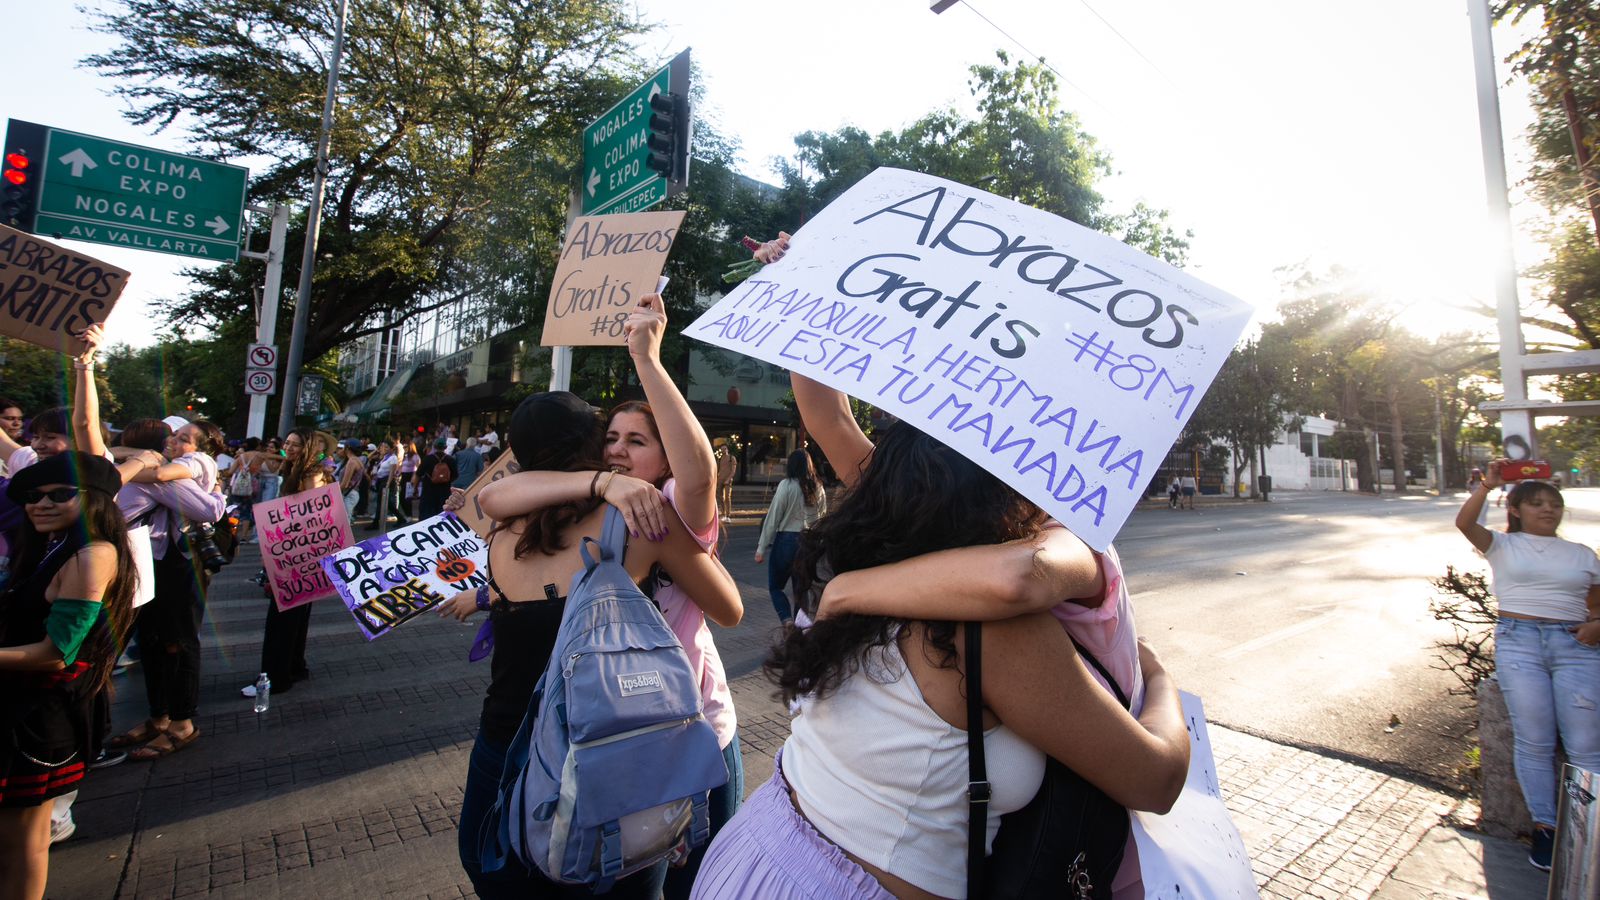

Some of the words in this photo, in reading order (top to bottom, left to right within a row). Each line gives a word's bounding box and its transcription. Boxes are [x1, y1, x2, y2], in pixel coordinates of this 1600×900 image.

[592, 95, 644, 148] NOGALES
[604, 127, 647, 169] COLIMA
[107, 151, 203, 182] COLIMA
[609, 158, 640, 191] EXPO
[120, 175, 186, 200] EXPO
[606, 186, 656, 215] PULTEPEC
[75, 195, 196, 228] NOGALES
[69, 225, 97, 239] AV.
[107, 230, 208, 255] VALLARTA
[563, 221, 674, 260] Abrazos
[0, 234, 120, 298] ABRAZOS
[853, 186, 1199, 349] Abrazos
[0, 274, 105, 337] RATIS
[553, 269, 632, 319] Gratis
[837, 253, 1041, 359] Gratis
[590, 311, 632, 337] #8
[253, 376, 268, 385] 30
[1065, 332, 1195, 421] #8M
[779, 329, 873, 382] ESTA
[877, 364, 935, 405] TU
[927, 393, 1110, 528] MANADA
[923, 343, 1144, 491] HERMANA
[268, 509, 285, 525] EL
[289, 494, 332, 520] FUEGO
[284, 522, 302, 535] de
[306, 514, 323, 529] mi
[279, 542, 342, 569] INCENDIA
[334, 550, 382, 584] DE
[360, 578, 383, 600] A
[384, 556, 440, 584] CASA
[436, 538, 479, 565] QUIERO
[439, 561, 468, 580] NO
[280, 571, 331, 602] JUSTI
[353, 578, 440, 634] LIBRE
